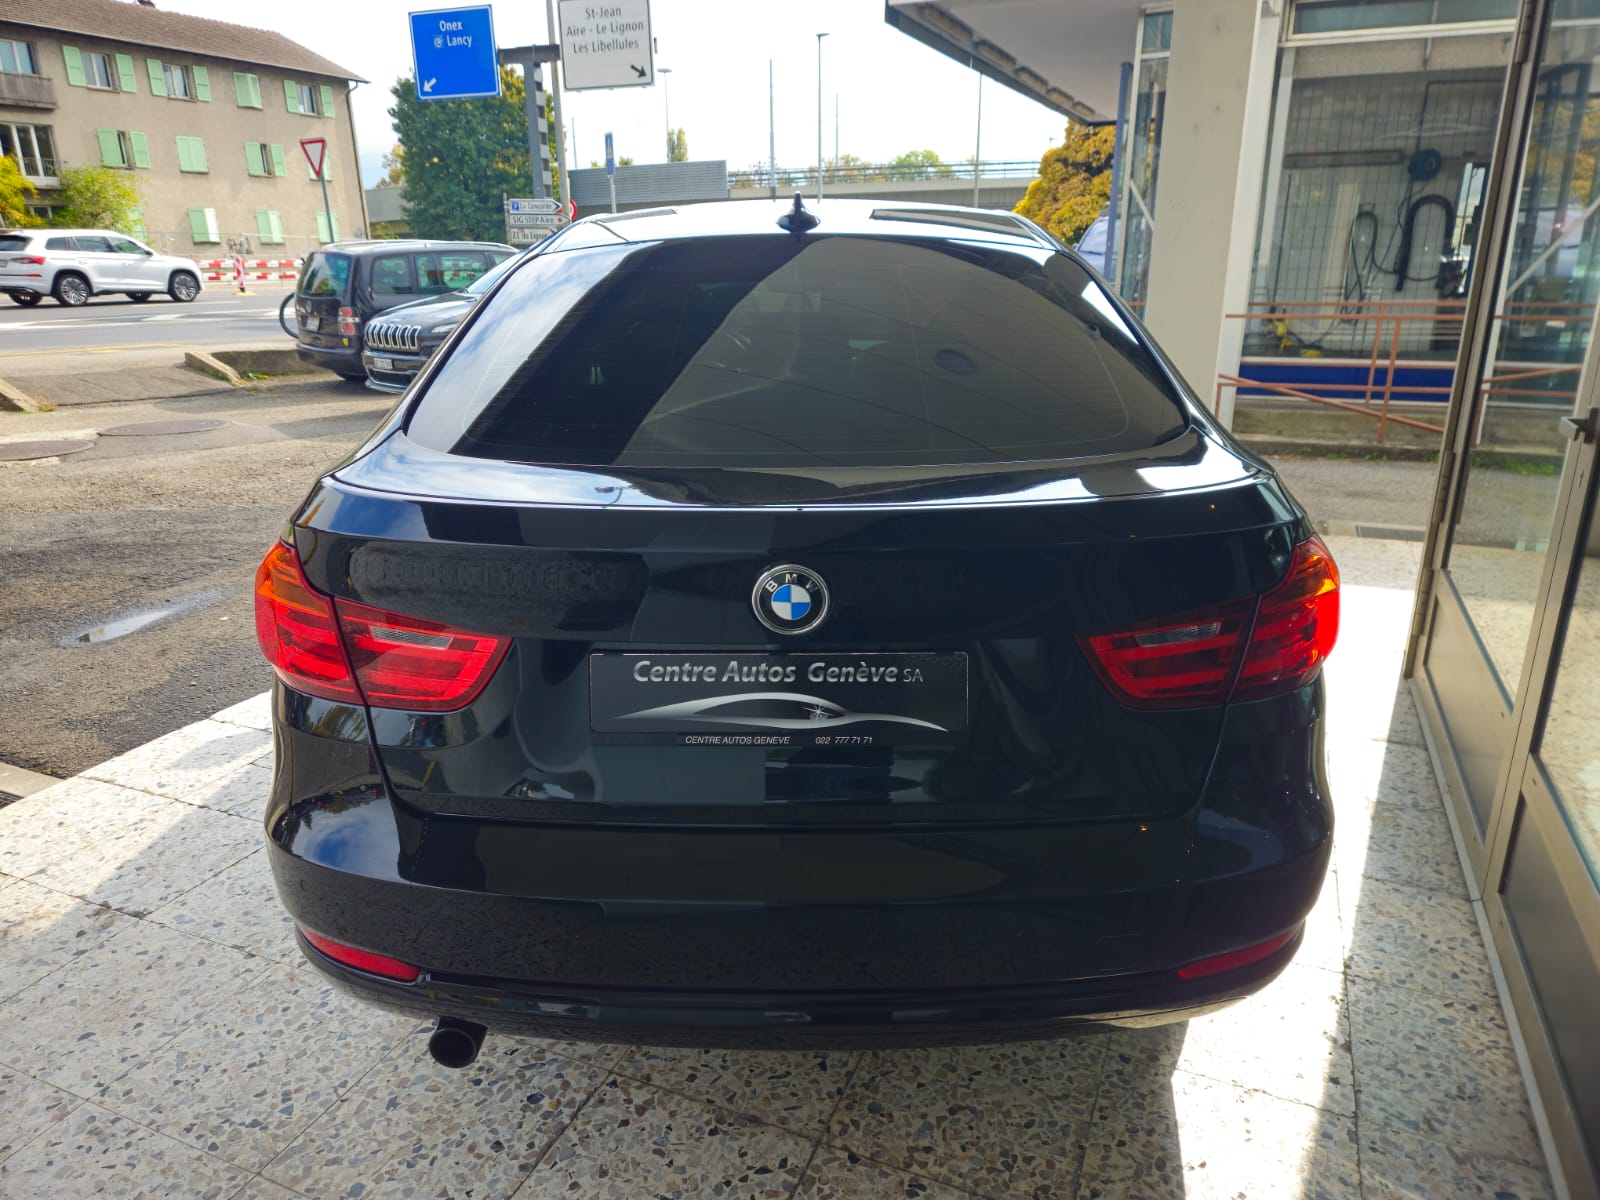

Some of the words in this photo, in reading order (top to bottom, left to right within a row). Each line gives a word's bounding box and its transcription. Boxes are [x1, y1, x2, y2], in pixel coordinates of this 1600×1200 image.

[585, 7, 622, 19] St-Jean
[439, 20, 463, 32] Onex
[596, 22, 607, 35] Le
[610, 21, 644, 35] Lignon
[446, 35, 472, 48] Lancy
[573, 43, 589, 54] Les
[592, 39, 639, 53] Libellules
[766, 573, 818, 592] BMW
[633, 660, 717, 682] Centre
[721, 660, 796, 683] Autos
[807, 661, 898, 683] Genève
[903, 668, 924, 683] SA
[685, 736, 722, 744] CENTRE
[722, 736, 752, 745] AUTOS
[753, 736, 790, 745] GENEVE
[815, 736, 831, 745] 022
[834, 736, 849, 745] 777
[851, 736, 861, 745] 71
[863, 736, 873, 745] 71
